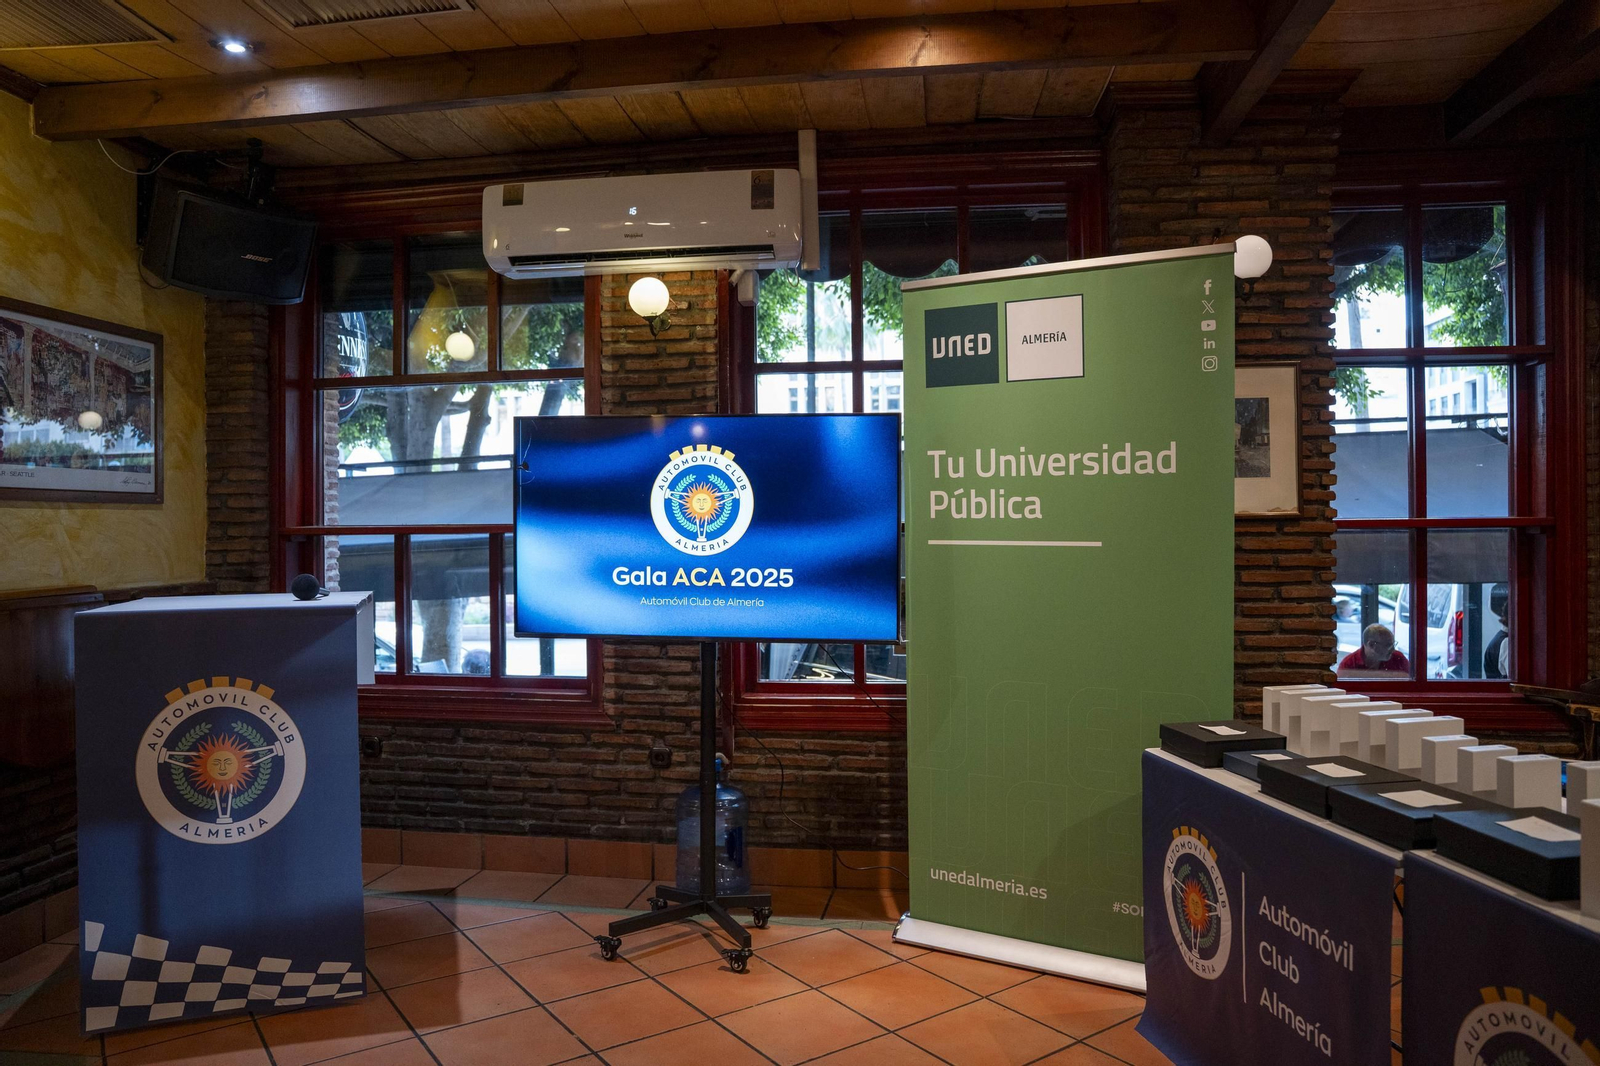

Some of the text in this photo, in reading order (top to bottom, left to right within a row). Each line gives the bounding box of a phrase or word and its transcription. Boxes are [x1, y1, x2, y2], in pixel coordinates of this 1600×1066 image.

[629, 206, 637, 215] 16
[241, 254, 273, 263] BOSE
[932, 332, 992, 359] UNED
[1021, 330, 1068, 345] ALMERÍA
[658, 455, 747, 491] AUTOMOVIL CLUB
[926, 440, 1177, 479] Tu Universidad
[929, 487, 1043, 519] Pública
[675, 538, 730, 552] ALMERIA
[612, 566, 795, 588] Gala ACA 2025
[639, 596, 765, 608] Automóvil Club de Almería
[147, 693, 296, 752] AUTOMOVIL CLUB
[179, 817, 269, 839] ALMERIA
[930, 867, 1048, 900] unedalmeria.es
[1167, 840, 1227, 909] AUTOMOVIL CLUB
[1258, 895, 1354, 972] Automóvil
[1258, 940, 1300, 984] Club
[1259, 986, 1332, 1057] Almería
[1463, 1011, 1571, 1061] AUTOMOVIL
